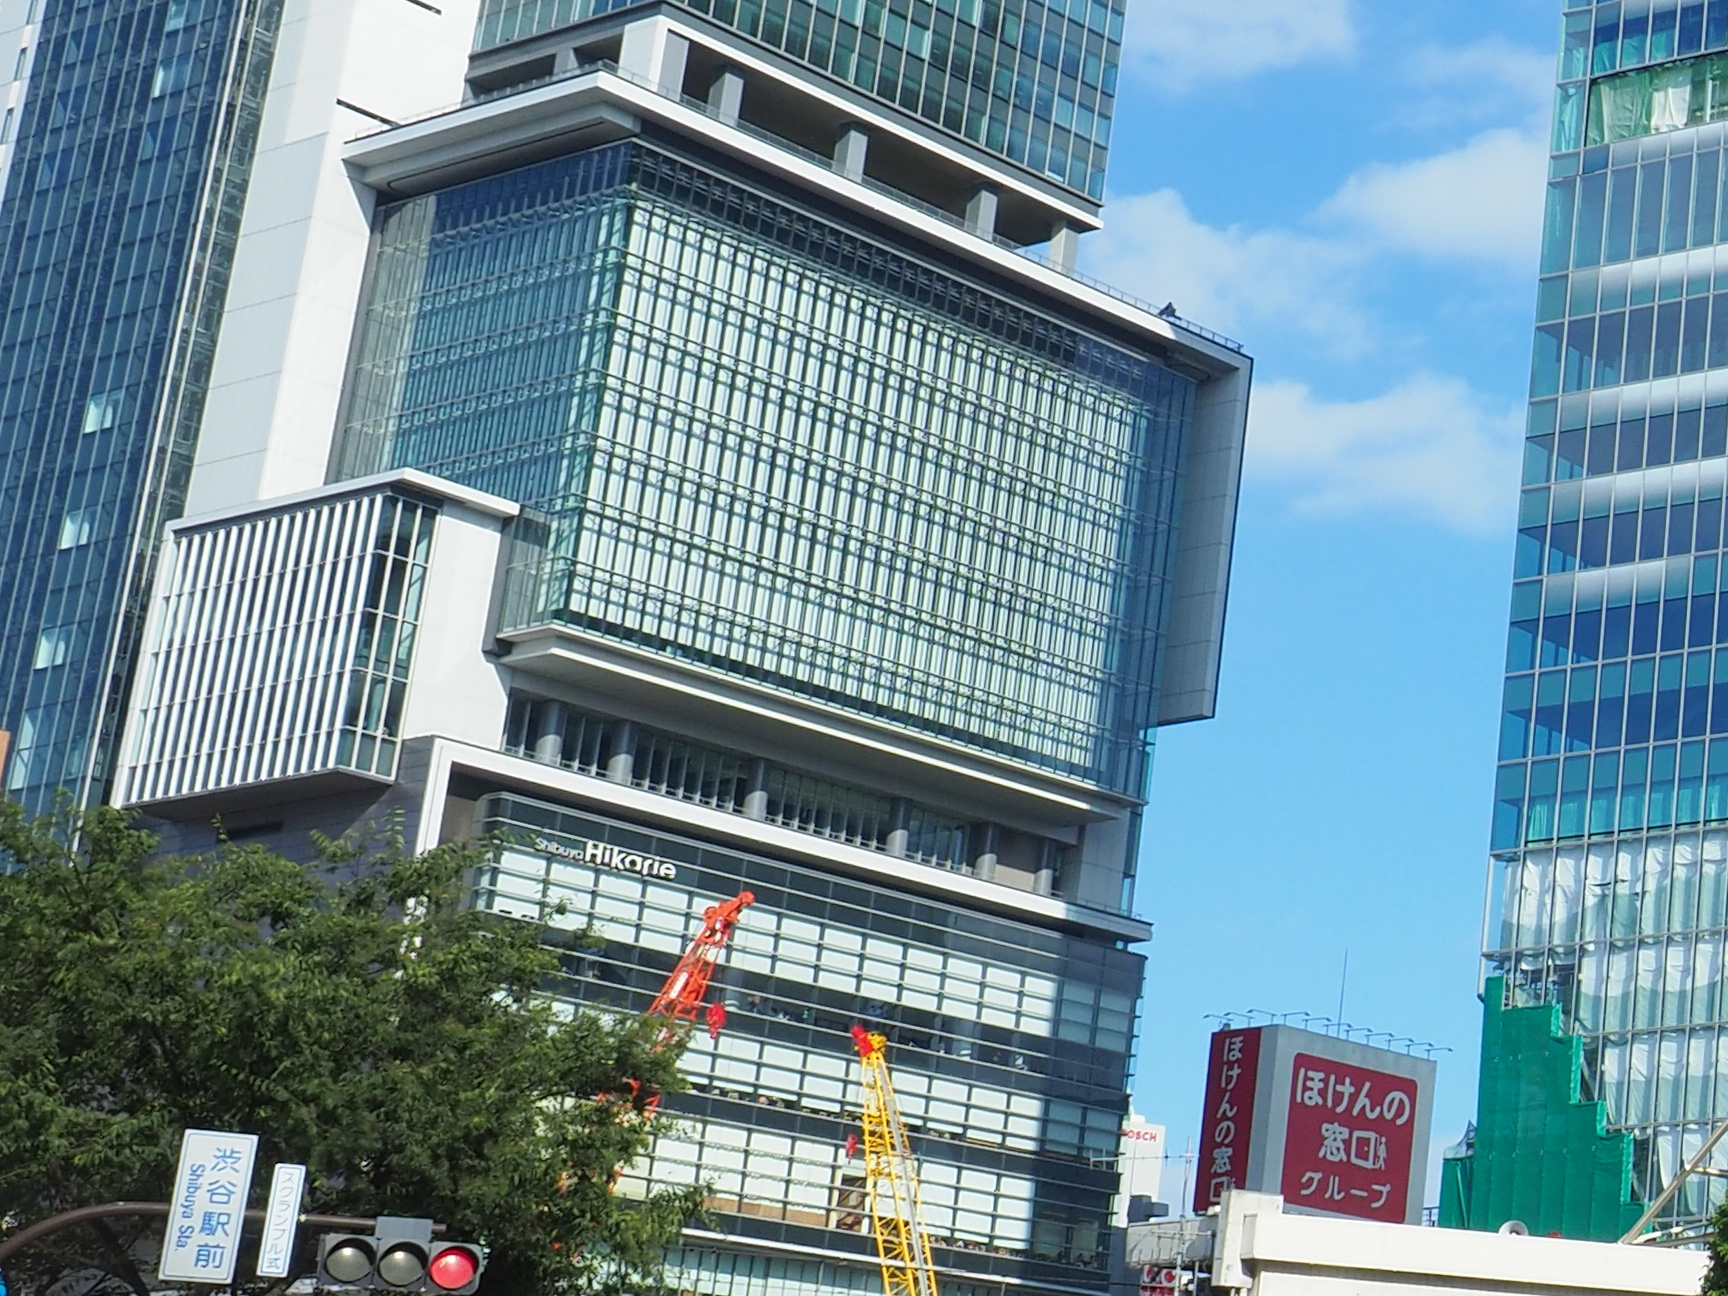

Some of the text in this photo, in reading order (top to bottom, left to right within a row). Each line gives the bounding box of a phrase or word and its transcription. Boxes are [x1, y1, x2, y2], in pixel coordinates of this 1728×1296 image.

[585, 840, 677, 880] Hikarie
[1209, 1037, 1243, 1202] ほけんの窓口
[1296, 1066, 1411, 1127] ほけんの
[1318, 1123, 1377, 1169] 窓口
[174, 1163, 206, 1252] Shibuya Sta.
[194, 1147, 243, 1269] 渋谷駅前
[1300, 1170, 1392, 1209] グループ
